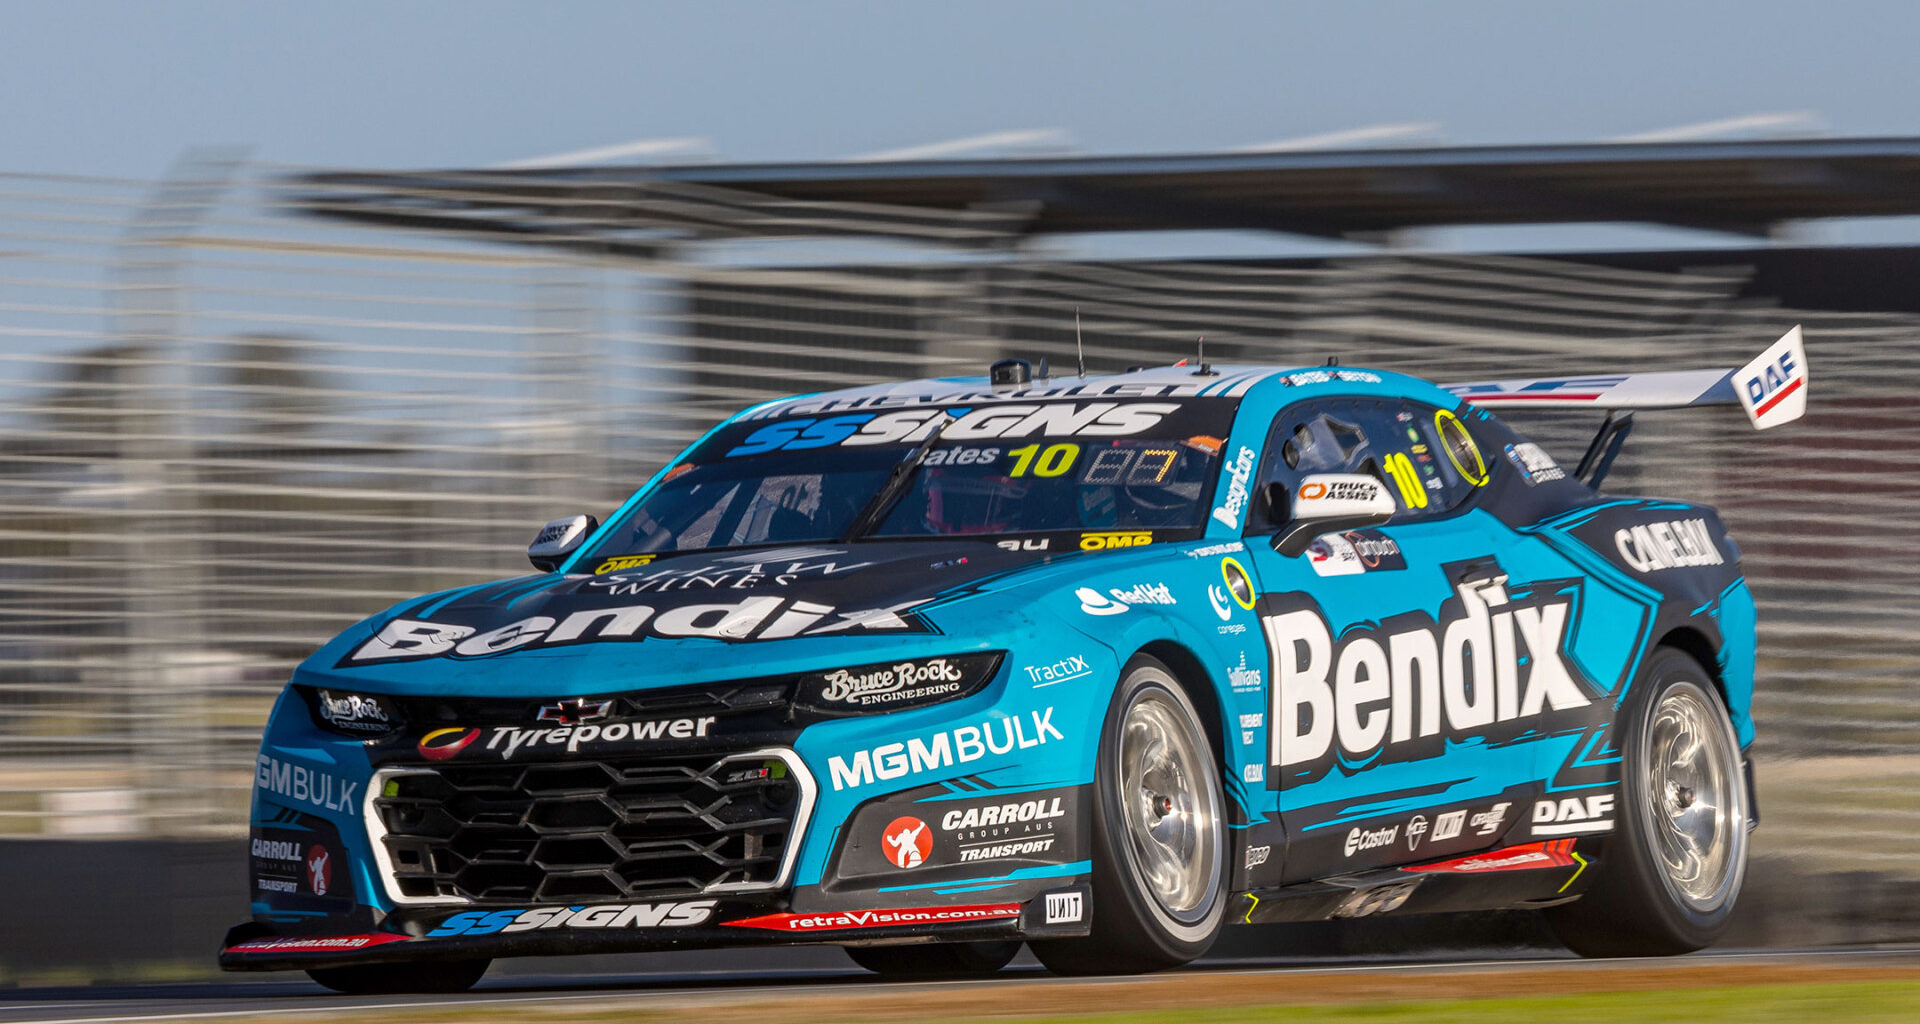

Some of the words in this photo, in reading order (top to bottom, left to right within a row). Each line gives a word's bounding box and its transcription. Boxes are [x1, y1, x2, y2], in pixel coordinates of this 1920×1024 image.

[1746, 351, 1795, 404] DAF
[1007, 443, 1080, 478] 10
[1328, 482, 1378, 491] TRUCK
[1384, 453, 1428, 508] 10
[1325, 491, 1377, 501] ASSIST
[1080, 531, 1153, 550] OMP
[594, 554, 657, 575] OMP
[609, 573, 798, 596] WINES
[352, 596, 935, 661] Bendix
[822, 669, 894, 702] Bruce
[893, 659, 962, 690] Rock
[1263, 573, 1593, 767] Bendix
[861, 682, 961, 706] ENGINEERING
[486, 715, 716, 759] Tyrepower
[827, 706, 1064, 791] MGMBULK
[257, 754, 359, 816] GMBULK
[942, 797, 1065, 831] CARROLL
[1532, 794, 1615, 823] DAF
[957, 827, 1010, 841] GROUP
[1024, 821, 1054, 833] AUS
[1358, 825, 1399, 851] Castrol
[252, 837, 302, 862] CARROLL
[960, 839, 1055, 862] TRANSPORT
